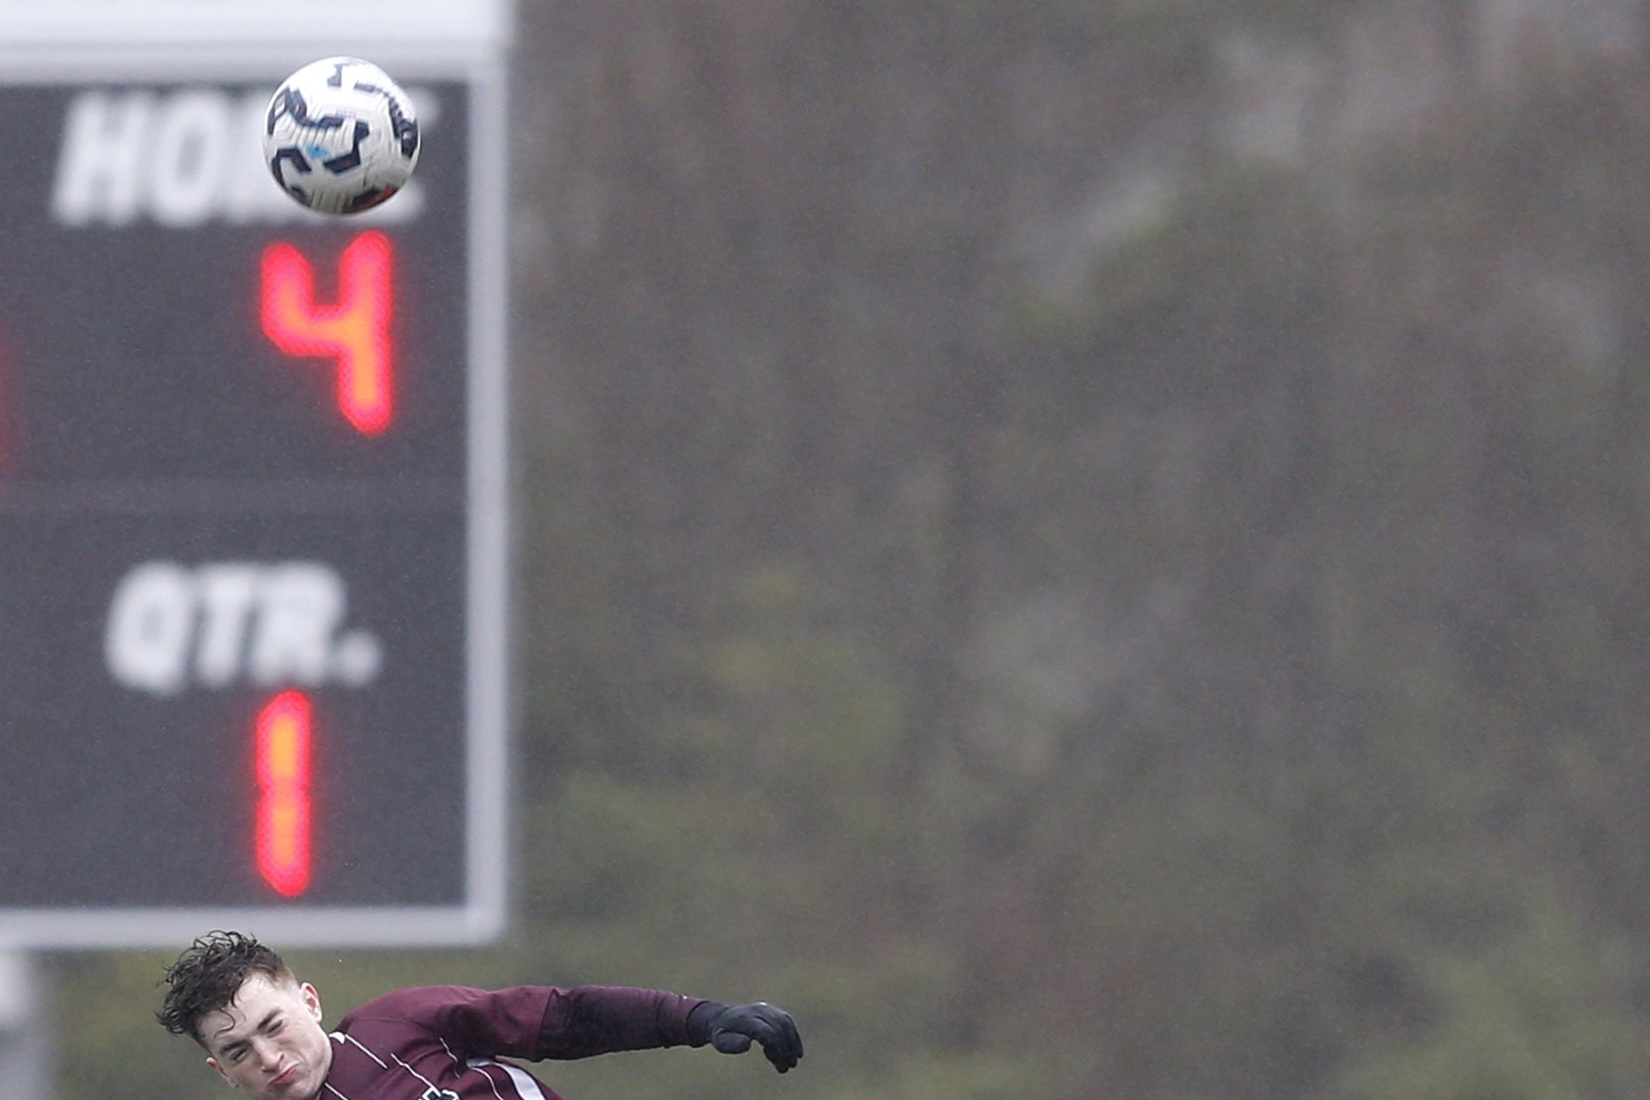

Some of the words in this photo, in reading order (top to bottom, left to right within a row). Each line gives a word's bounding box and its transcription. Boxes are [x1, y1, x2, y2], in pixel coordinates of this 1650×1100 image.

[260, 230, 394, 437] 4
[104, 558, 384, 696] QTR.
[254, 688, 313, 898] 1
